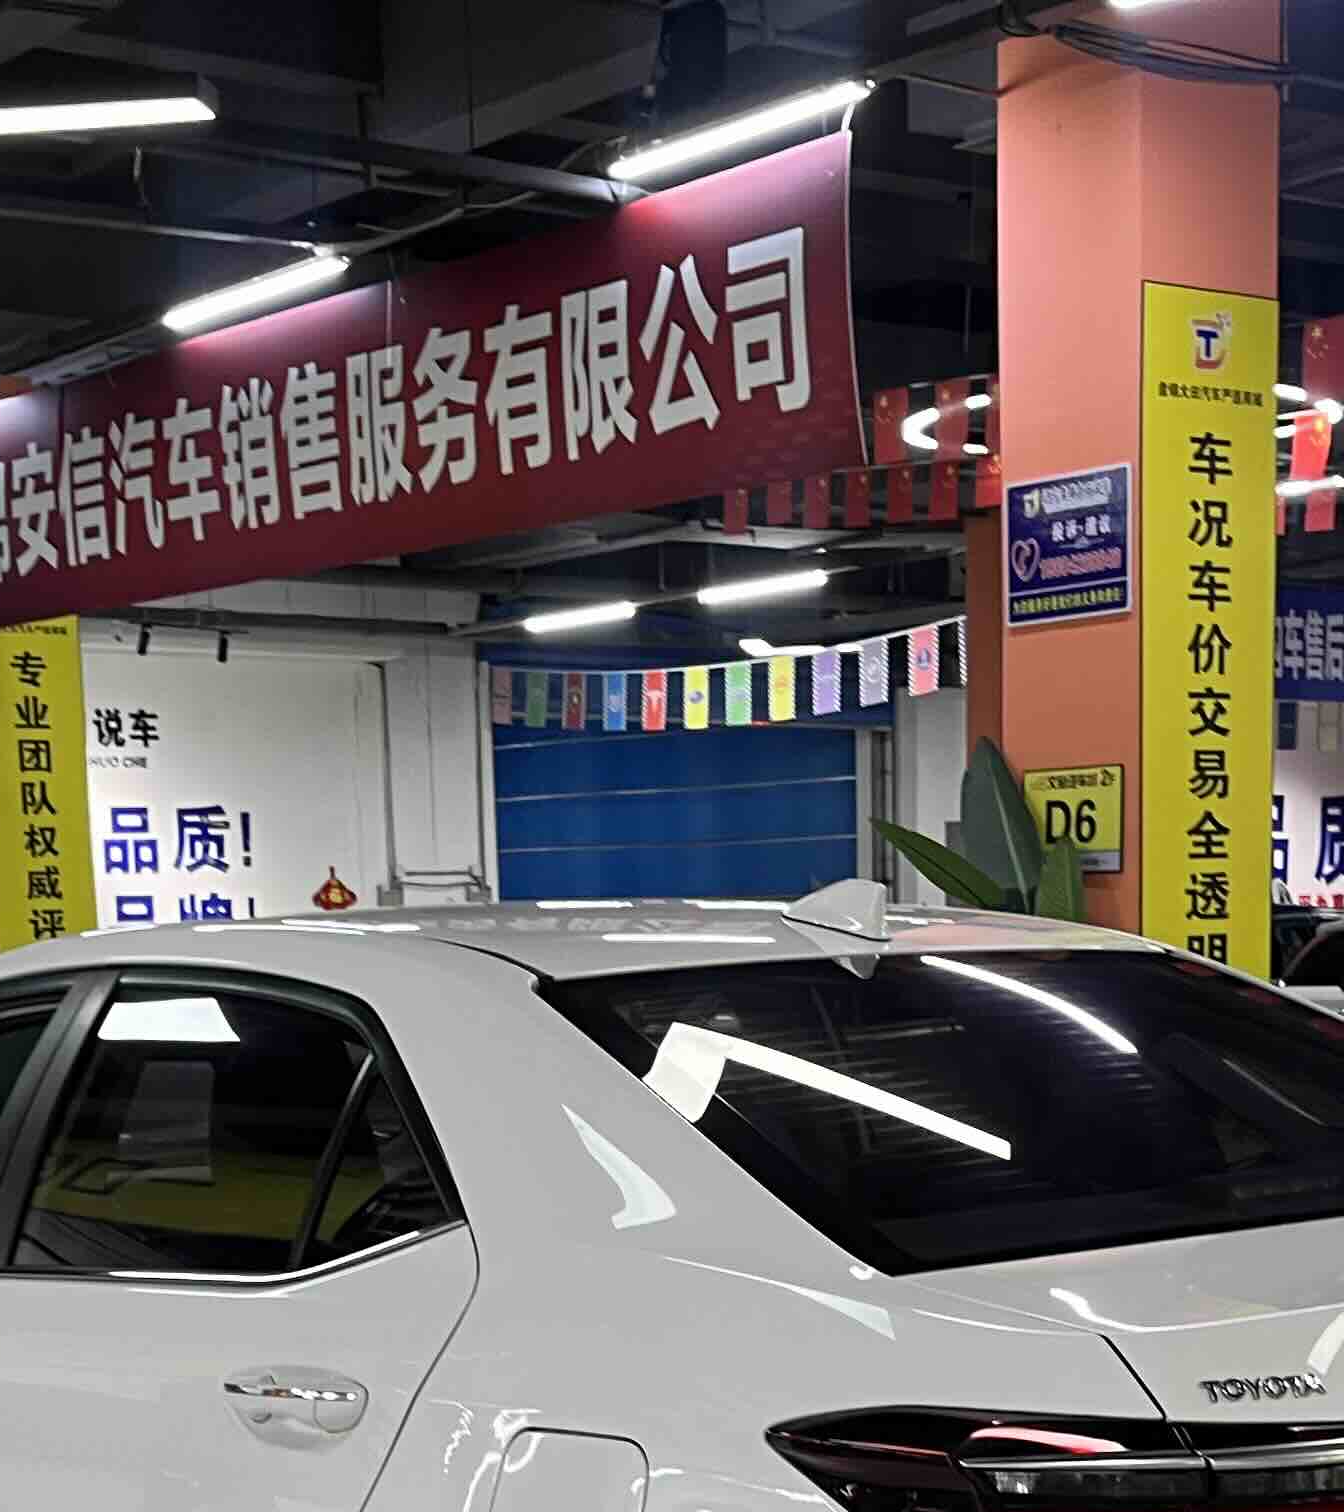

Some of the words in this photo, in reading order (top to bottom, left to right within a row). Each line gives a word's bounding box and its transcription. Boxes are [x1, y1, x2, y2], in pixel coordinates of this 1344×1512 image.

[1184, 432, 1233, 965] 车况车价交易全透明
[1045, 799, 1097, 845] D6
[1198, 1374, 1327, 1403] TOYOTA
